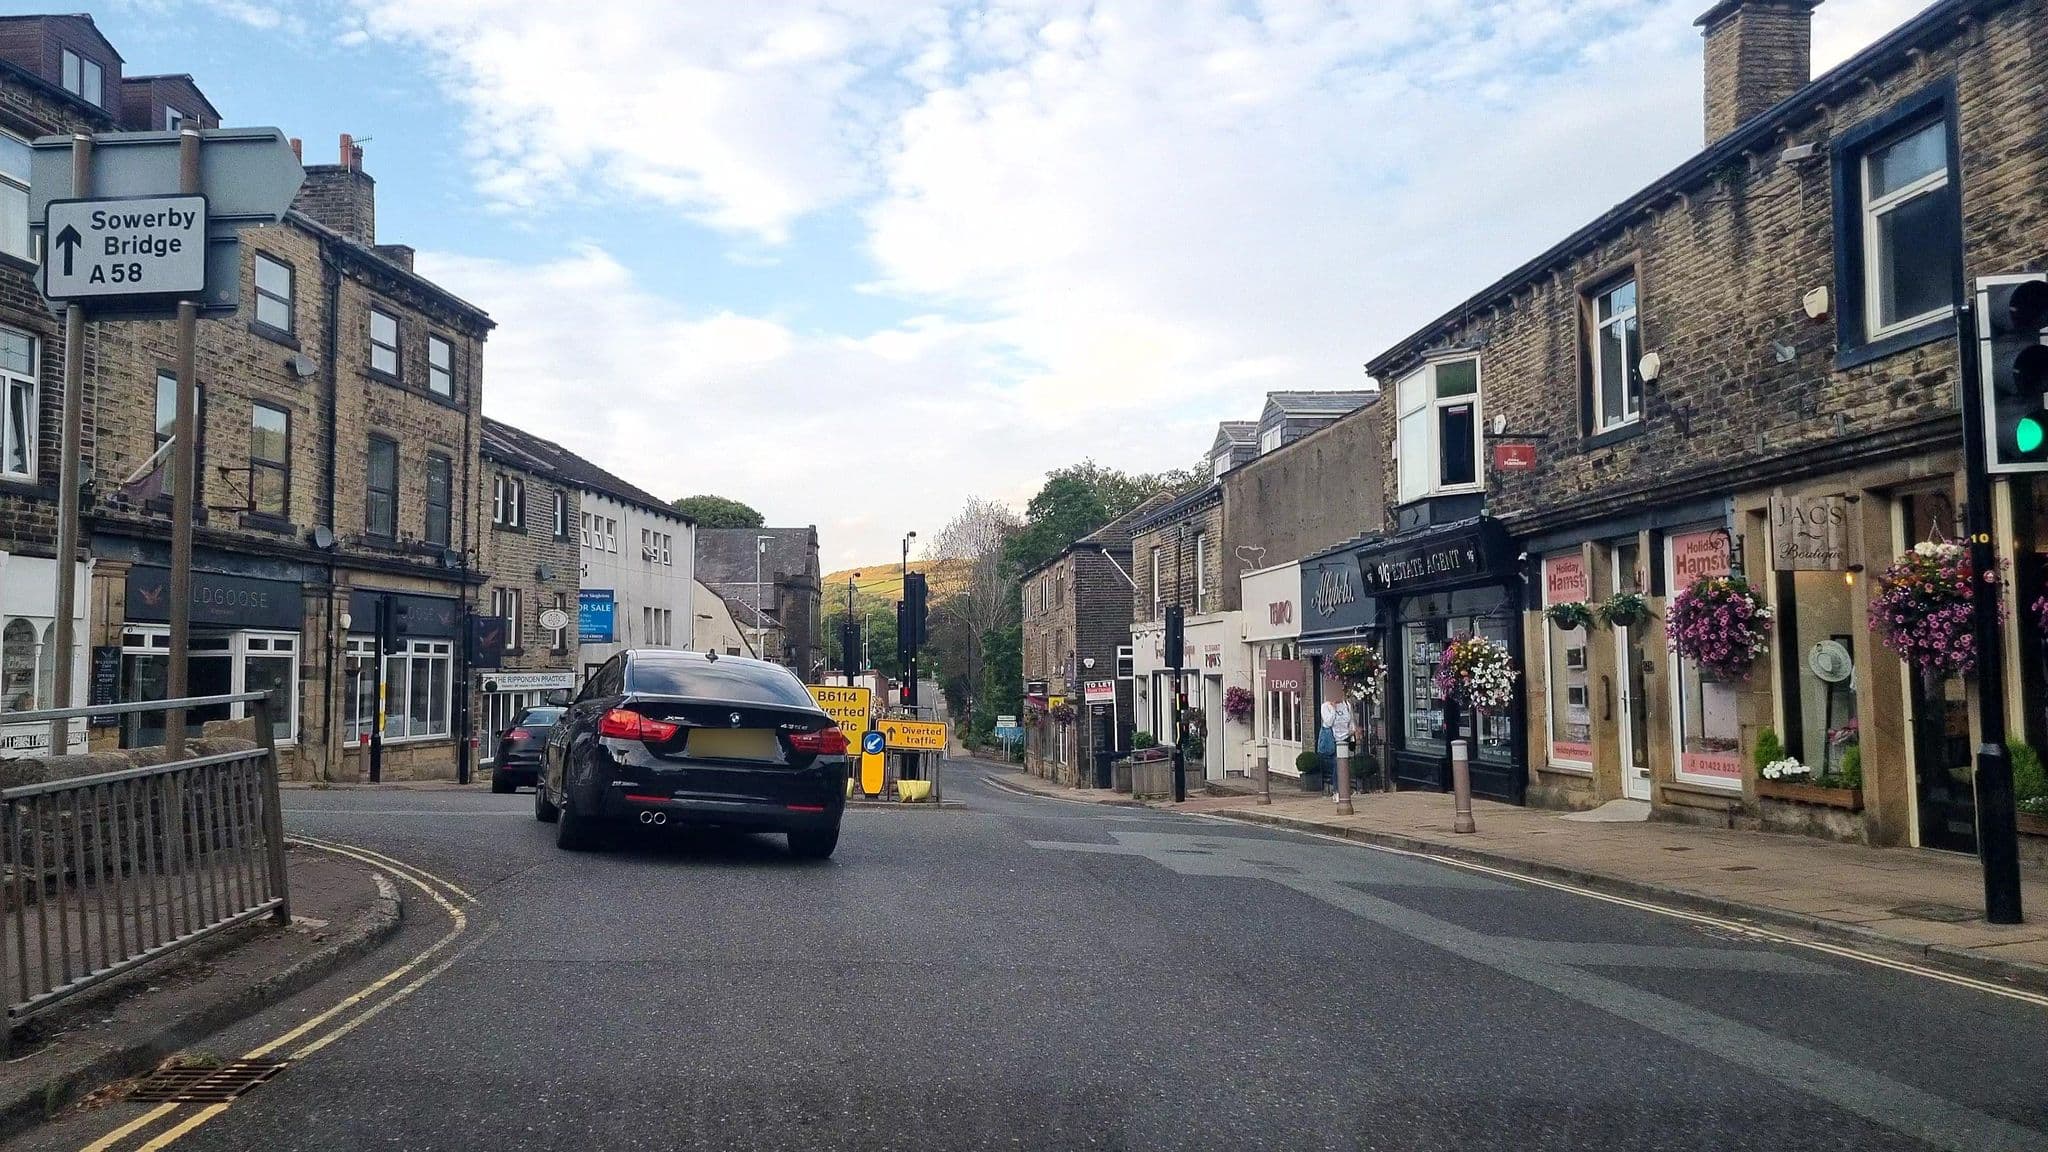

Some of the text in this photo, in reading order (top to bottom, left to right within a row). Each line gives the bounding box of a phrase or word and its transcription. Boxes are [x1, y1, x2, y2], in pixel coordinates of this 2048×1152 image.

[90, 207, 196, 232] Sowerby
[104, 235, 182, 257] Bridge
[89, 263, 143, 284] A58
[1971, 533, 1989, 543] 10
[1392, 558, 1424, 581] ESTATE
[1427, 549, 1460, 574] AGENT
[1556, 563, 1579, 574] Holiday
[1676, 550, 1729, 575] Hamst
[1549, 571, 1584, 592] Hamst
[193, 584, 269, 608] LDGOOSE
[591, 604, 611, 612] SALE
[1269, 600, 1292, 625] TEMPO
[507, 675, 540, 684] RIPPONDEN
[541, 675, 567, 683] PRACTICE
[1271, 680, 1298, 689] TEMPO
[902, 727, 941, 735] Diverted
[906, 736, 936, 746] traffic
